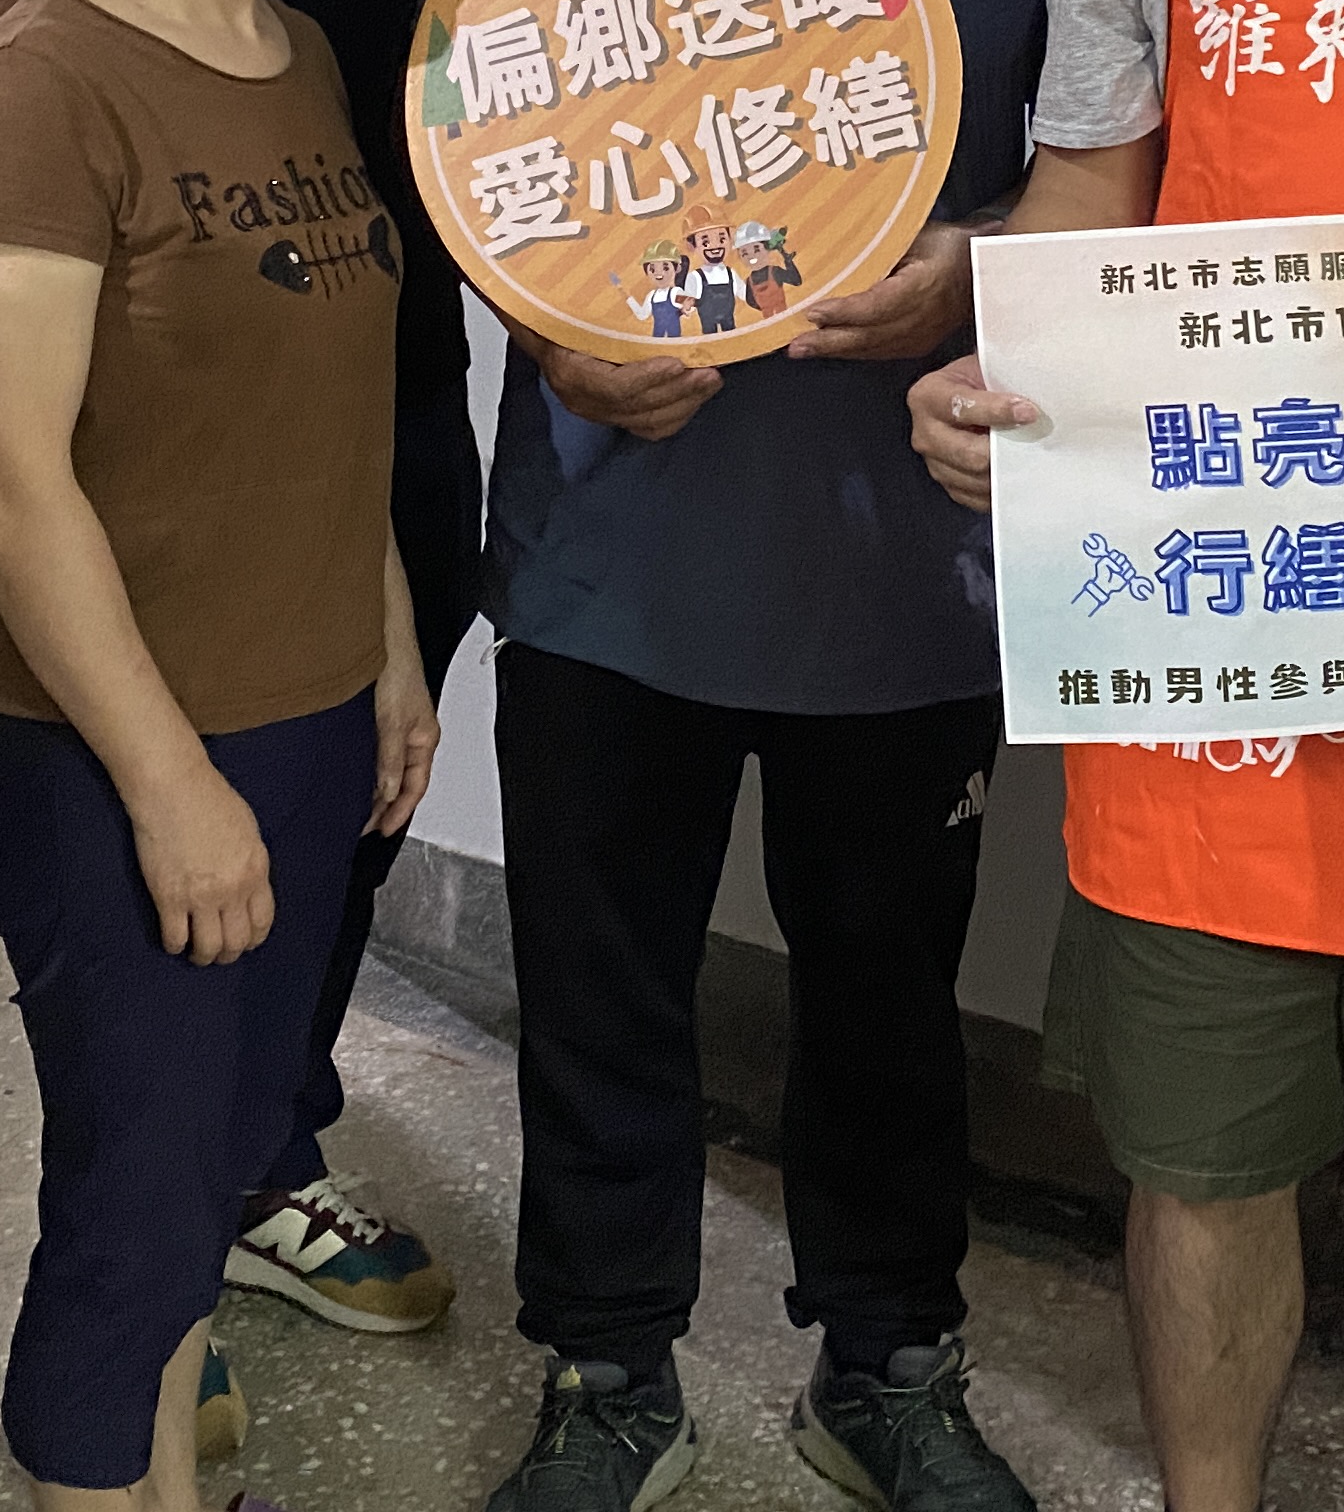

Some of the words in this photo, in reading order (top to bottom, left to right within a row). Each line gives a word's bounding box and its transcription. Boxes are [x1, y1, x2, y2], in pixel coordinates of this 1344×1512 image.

[171, 152, 382, 243] Fashio
[470, 49, 925, 259] 愛心修繕
